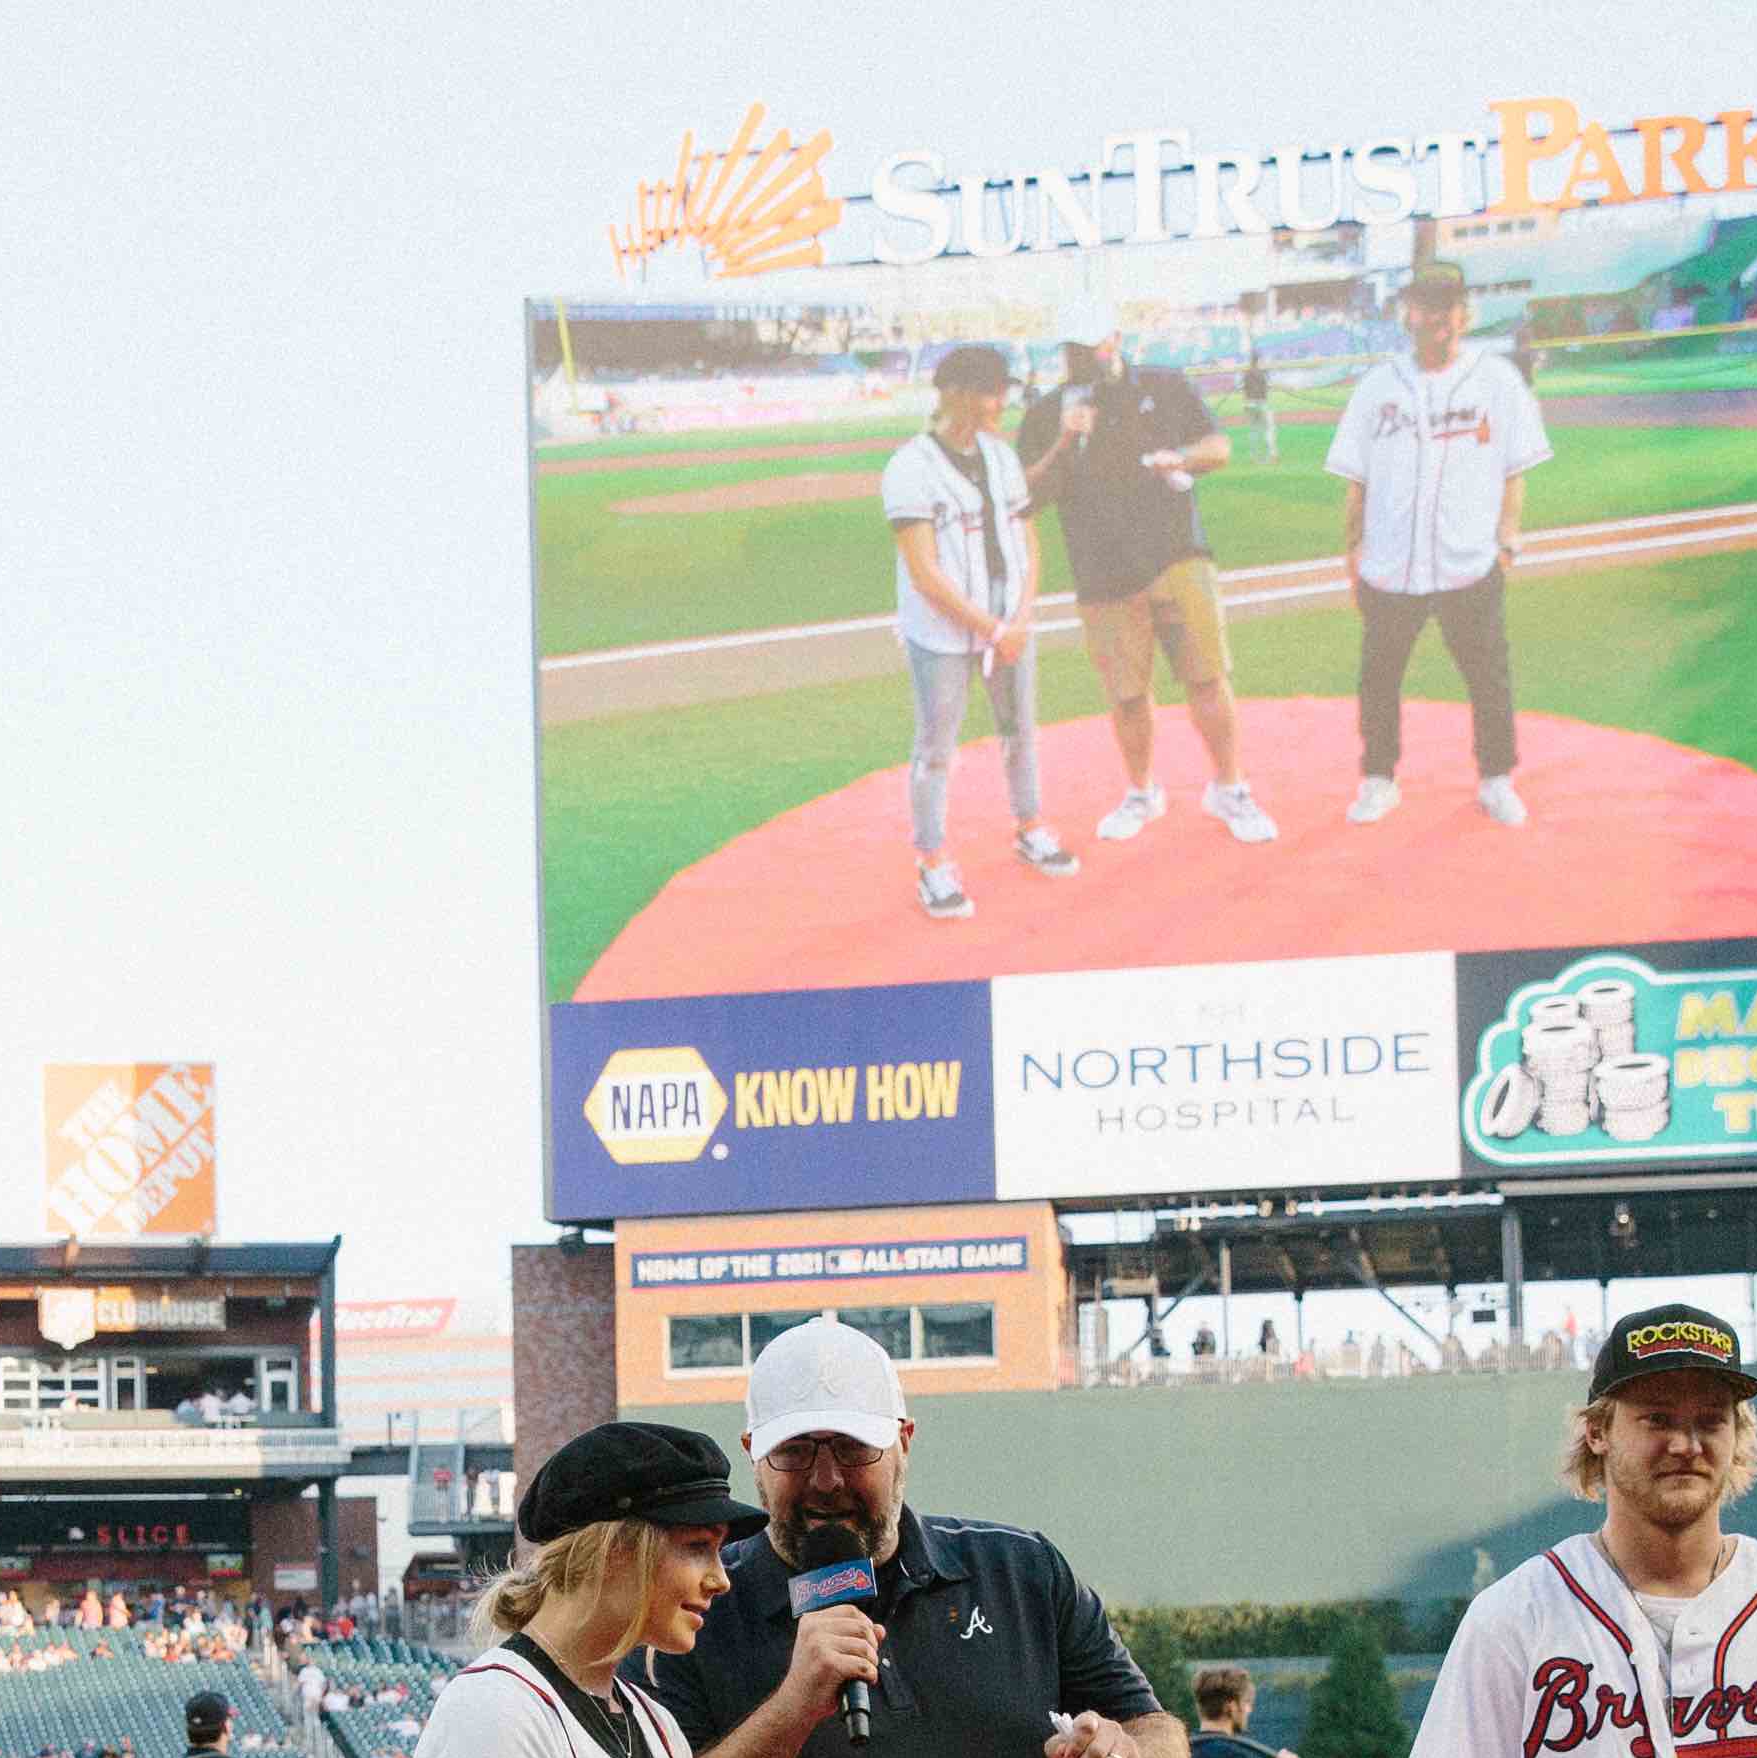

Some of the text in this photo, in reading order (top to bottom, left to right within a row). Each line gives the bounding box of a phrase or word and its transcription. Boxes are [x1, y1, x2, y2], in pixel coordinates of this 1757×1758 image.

[1021, 1031, 1432, 1092] NORTHSIDE
[610, 1060, 962, 1131] NAPA KNOW HOW
[1097, 1096, 1356, 1136] HOSPITAL
[1626, 1321, 1734, 1354] ROCKSTAR
[96, 1524, 191, 1546] SLICE
[960, 1605, 993, 1639] A
